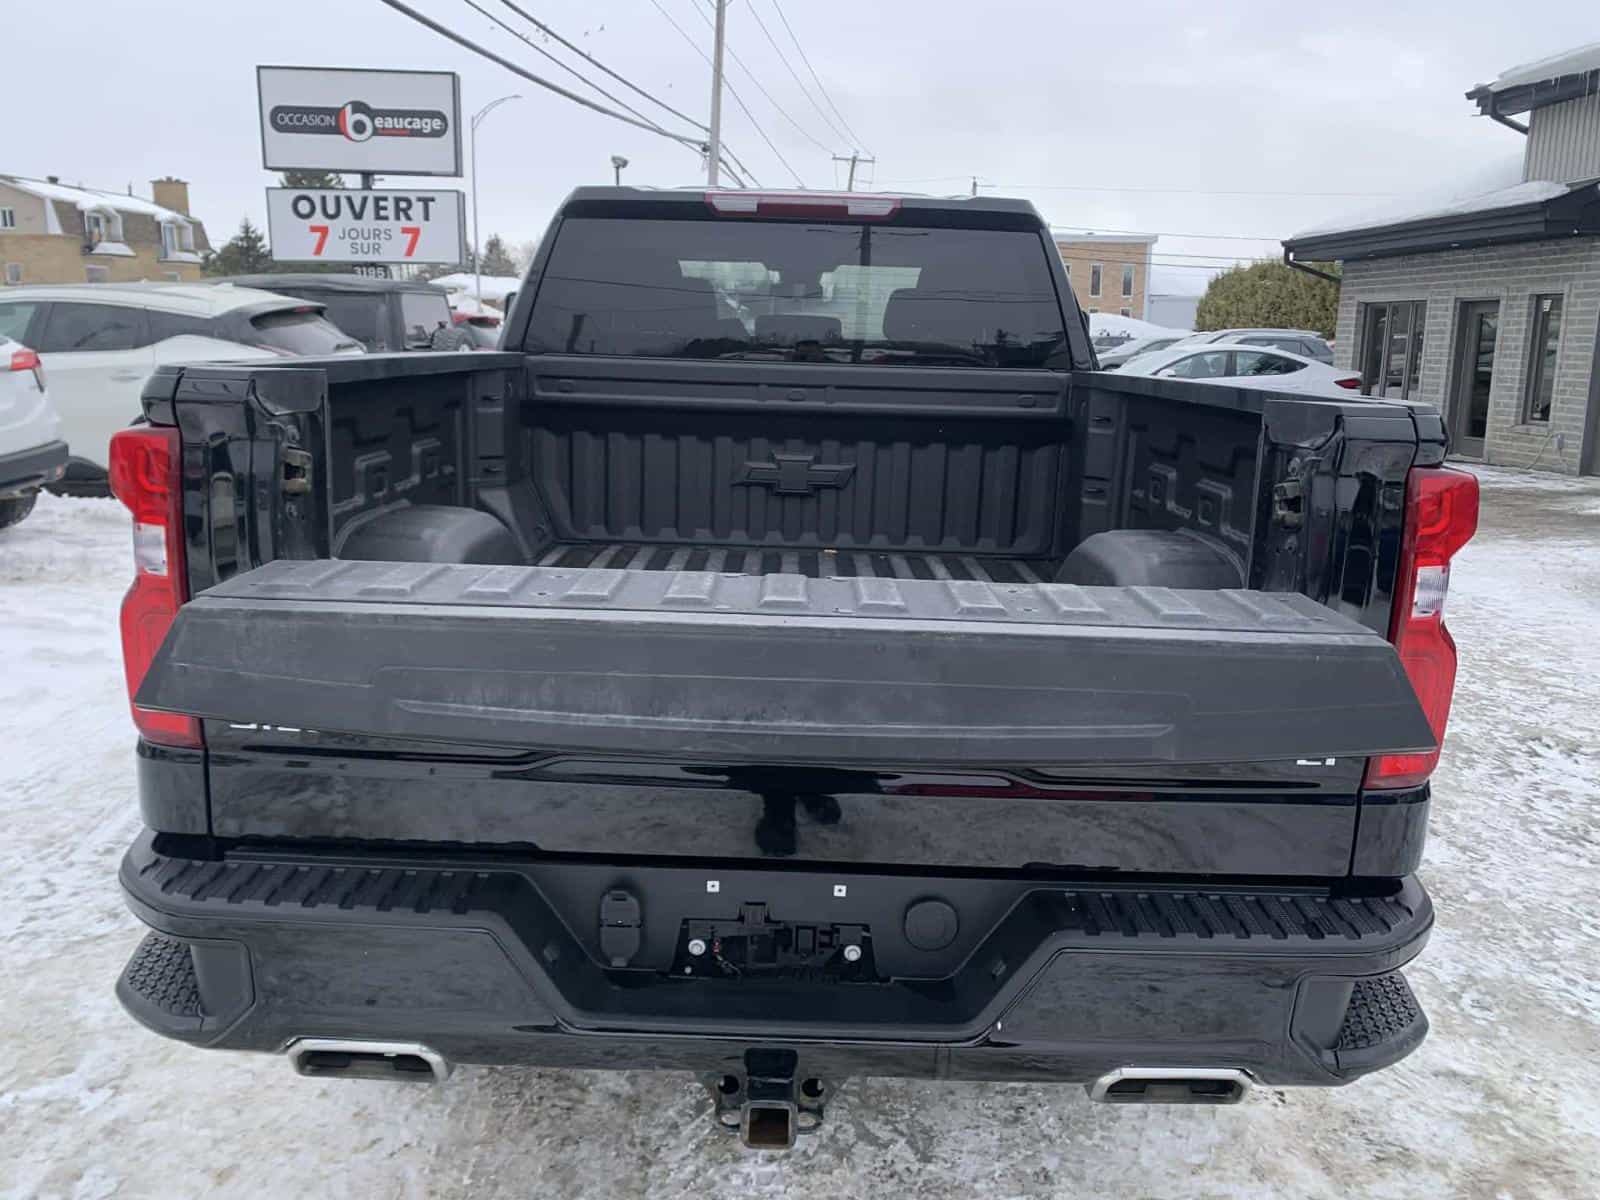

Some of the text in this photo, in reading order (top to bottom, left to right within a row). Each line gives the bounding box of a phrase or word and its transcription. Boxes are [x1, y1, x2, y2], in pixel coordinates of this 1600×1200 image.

[276, 113, 336, 127] OCCASION
[291, 194, 436, 222] OUVERT
[308, 225, 422, 257] 7 JOURS 7
[350, 242, 381, 255] SUR
